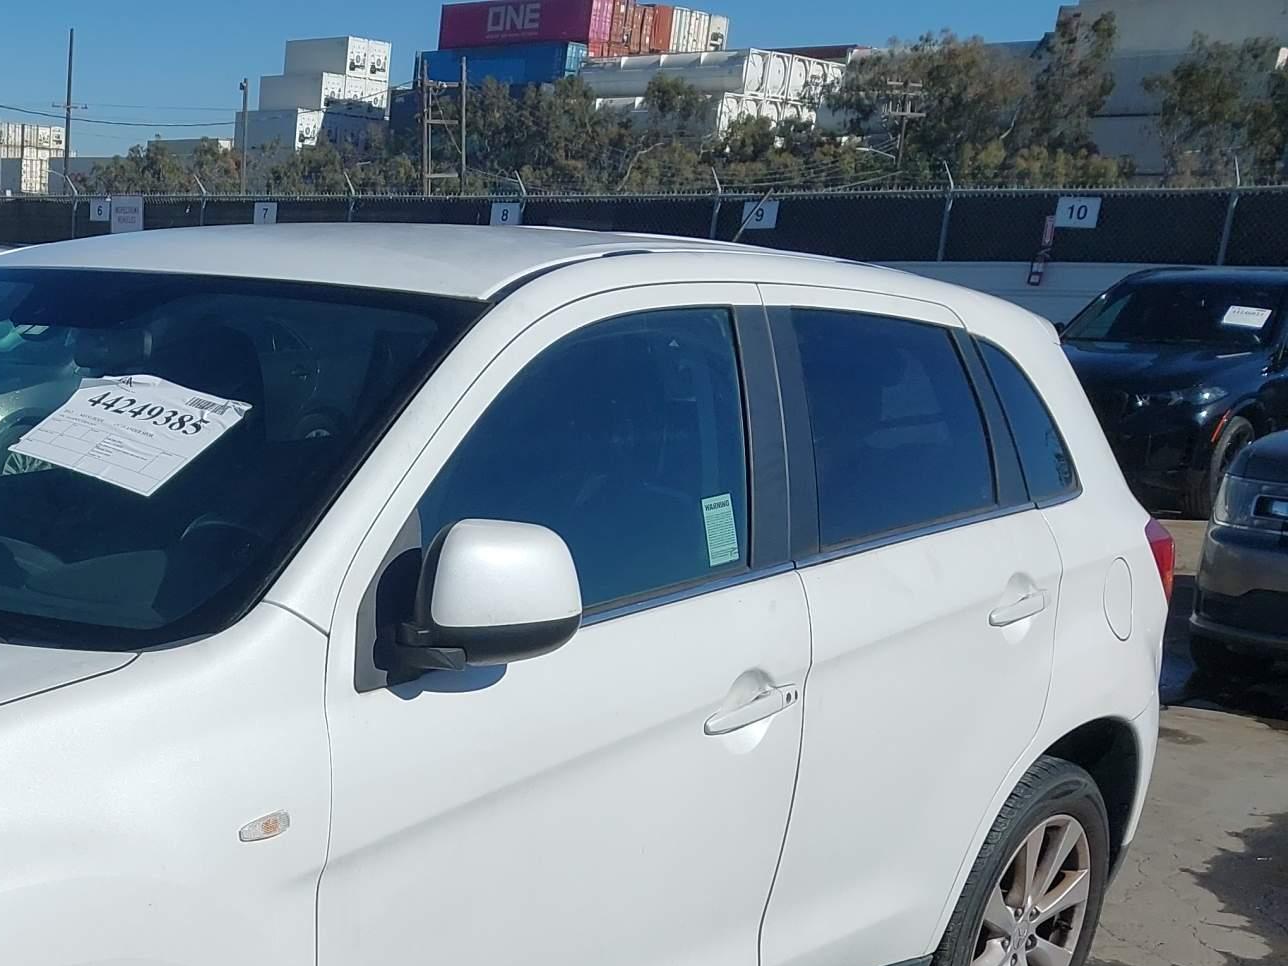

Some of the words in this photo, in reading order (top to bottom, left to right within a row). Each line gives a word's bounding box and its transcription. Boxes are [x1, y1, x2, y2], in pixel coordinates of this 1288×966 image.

[487, 3, 541, 32] ONE
[97, 205, 103, 216] 6
[262, 207, 269, 219] 7
[501, 209, 509, 221] 8
[755, 208, 765, 222] 9
[1067, 204, 1089, 221] 10
[88, 391, 211, 436] 44249385
